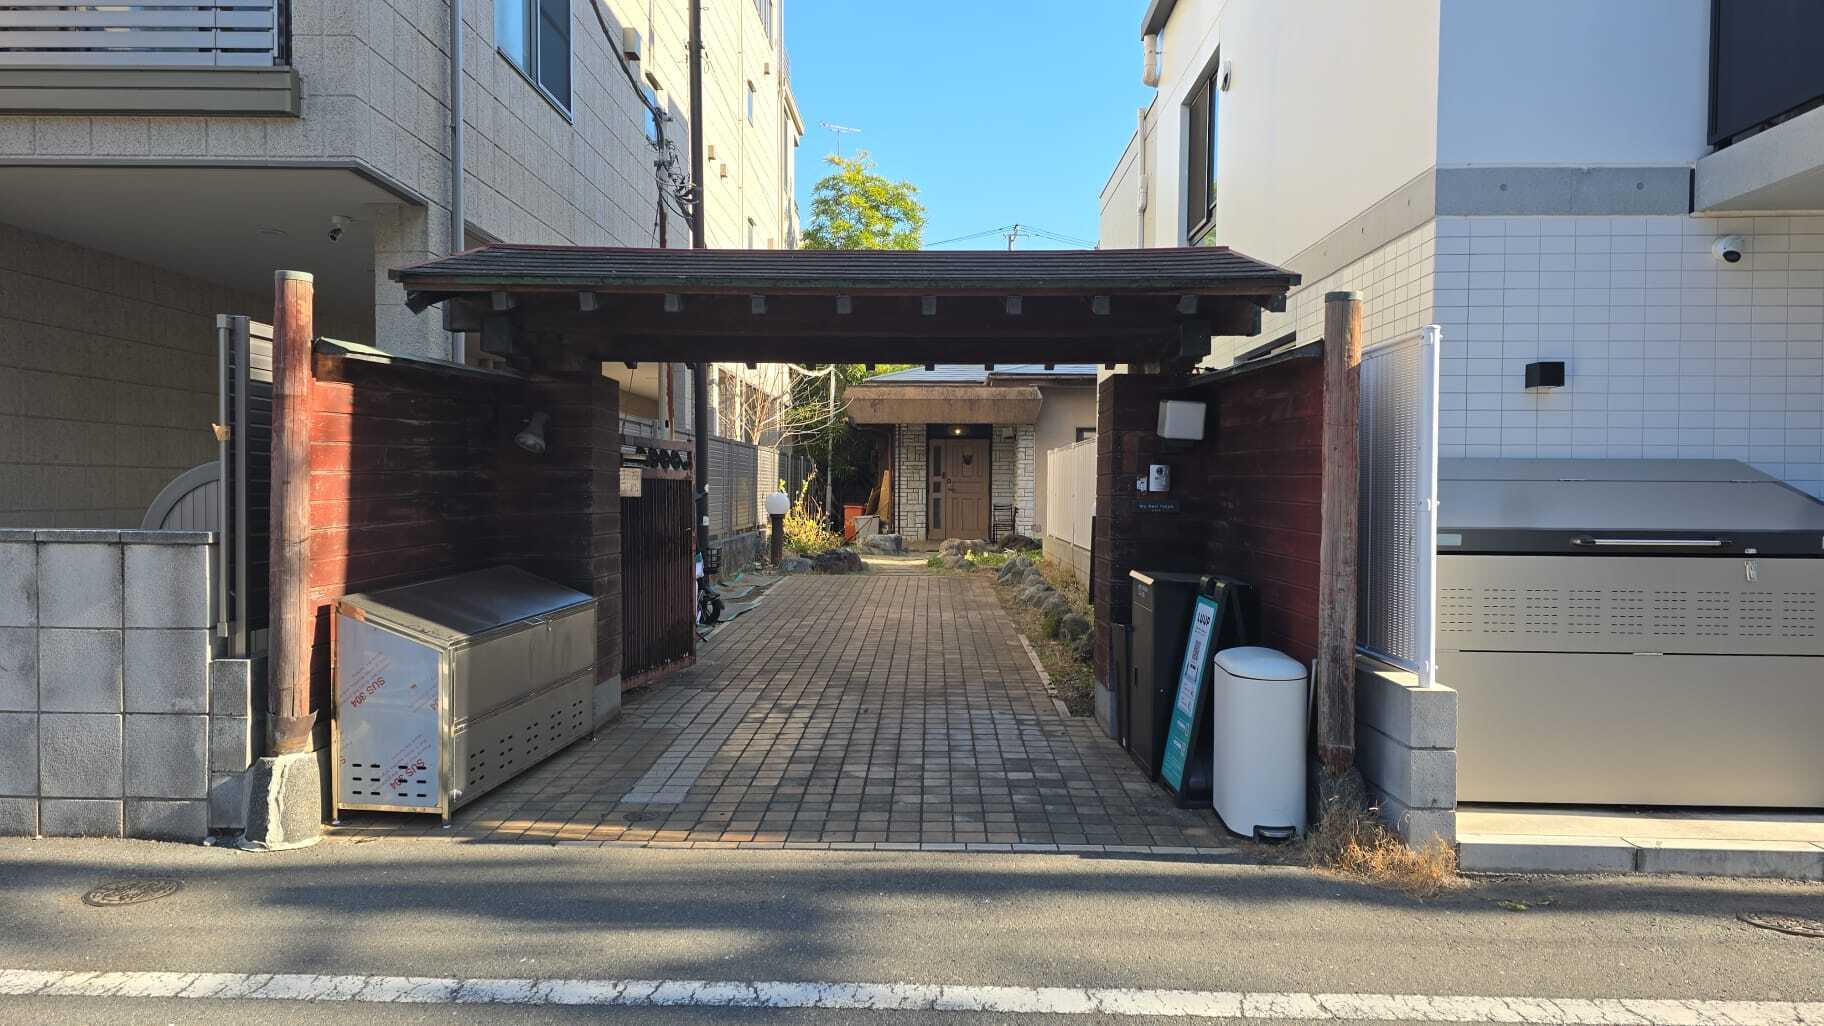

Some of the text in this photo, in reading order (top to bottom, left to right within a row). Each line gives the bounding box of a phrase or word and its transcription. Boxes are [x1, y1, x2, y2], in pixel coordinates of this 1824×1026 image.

[350, 676, 386, 708] SUS 304
[405, 758, 425, 777] SUS
